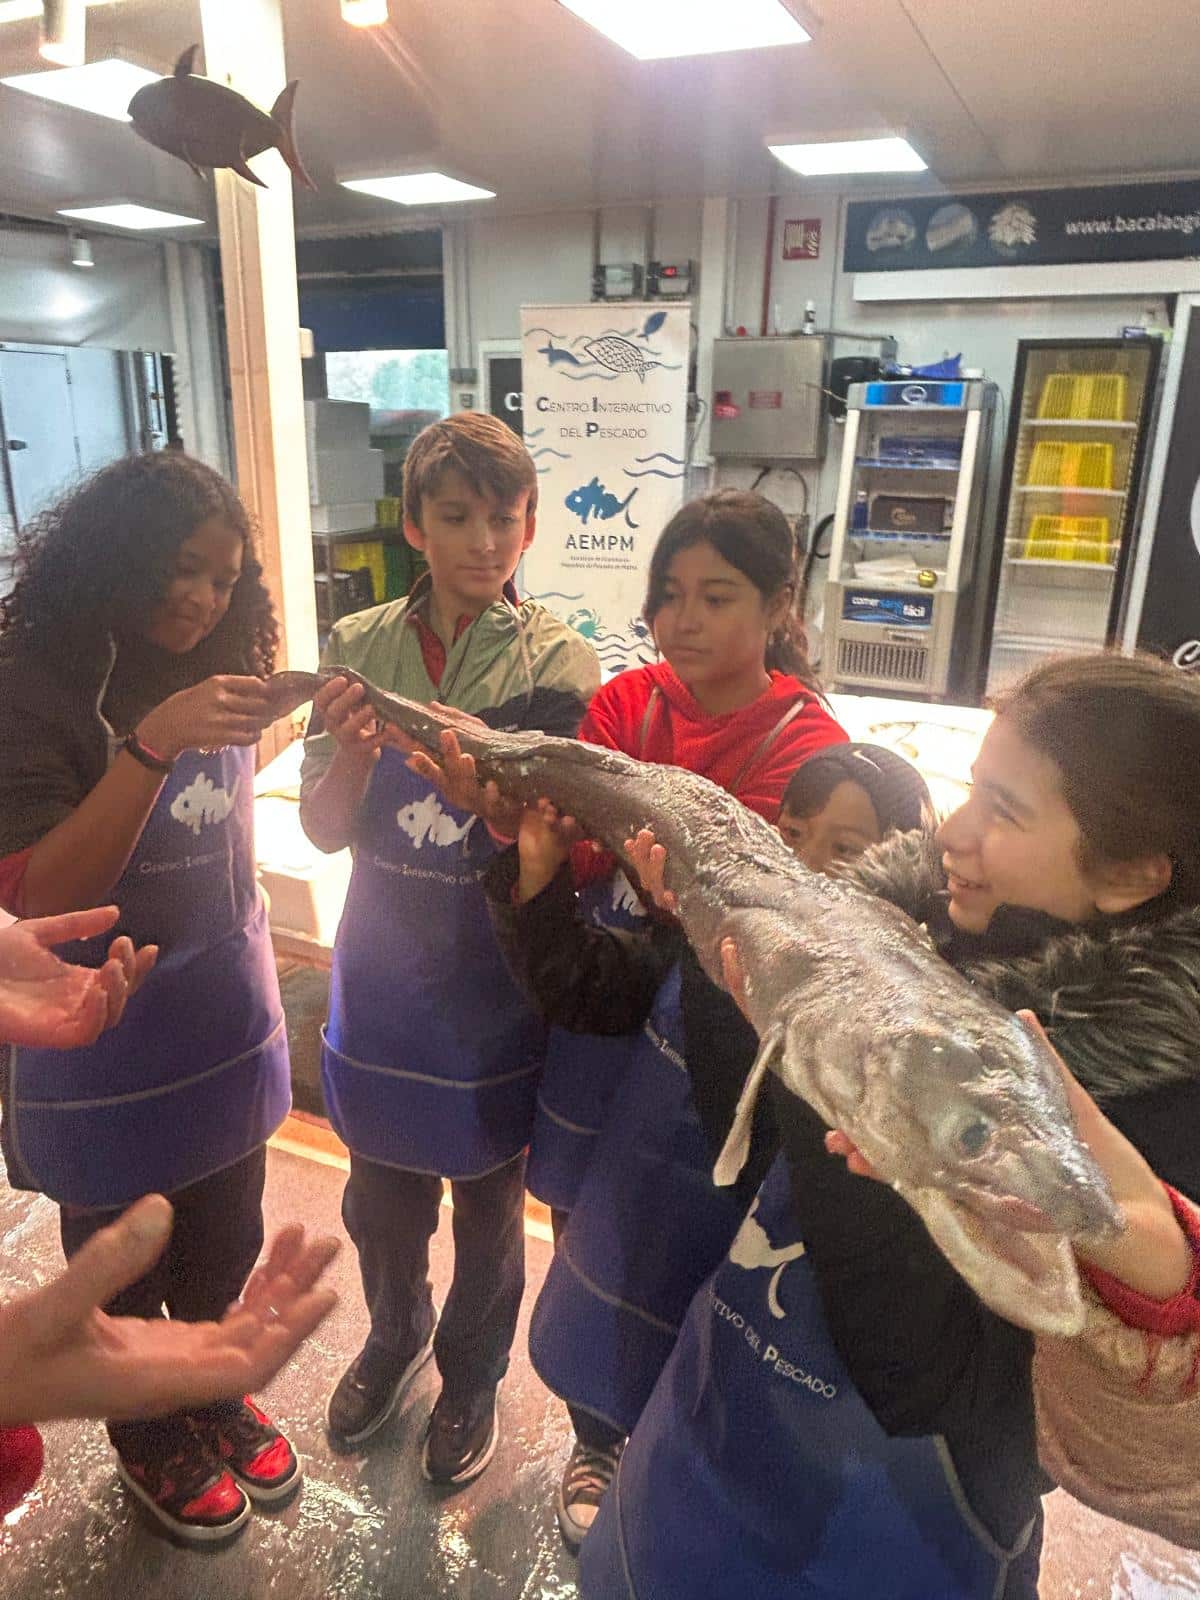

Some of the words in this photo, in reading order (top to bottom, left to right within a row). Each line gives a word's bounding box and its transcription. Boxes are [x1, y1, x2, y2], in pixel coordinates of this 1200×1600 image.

[536, 397, 590, 413] CENTRO
[592, 396, 672, 415] INTERACTIVO
[559, 426, 583, 439] DEL
[585, 421, 648, 439] PESCADO
[565, 534, 634, 552] AEMPM
[763, 1344, 837, 1399] PESCADO
